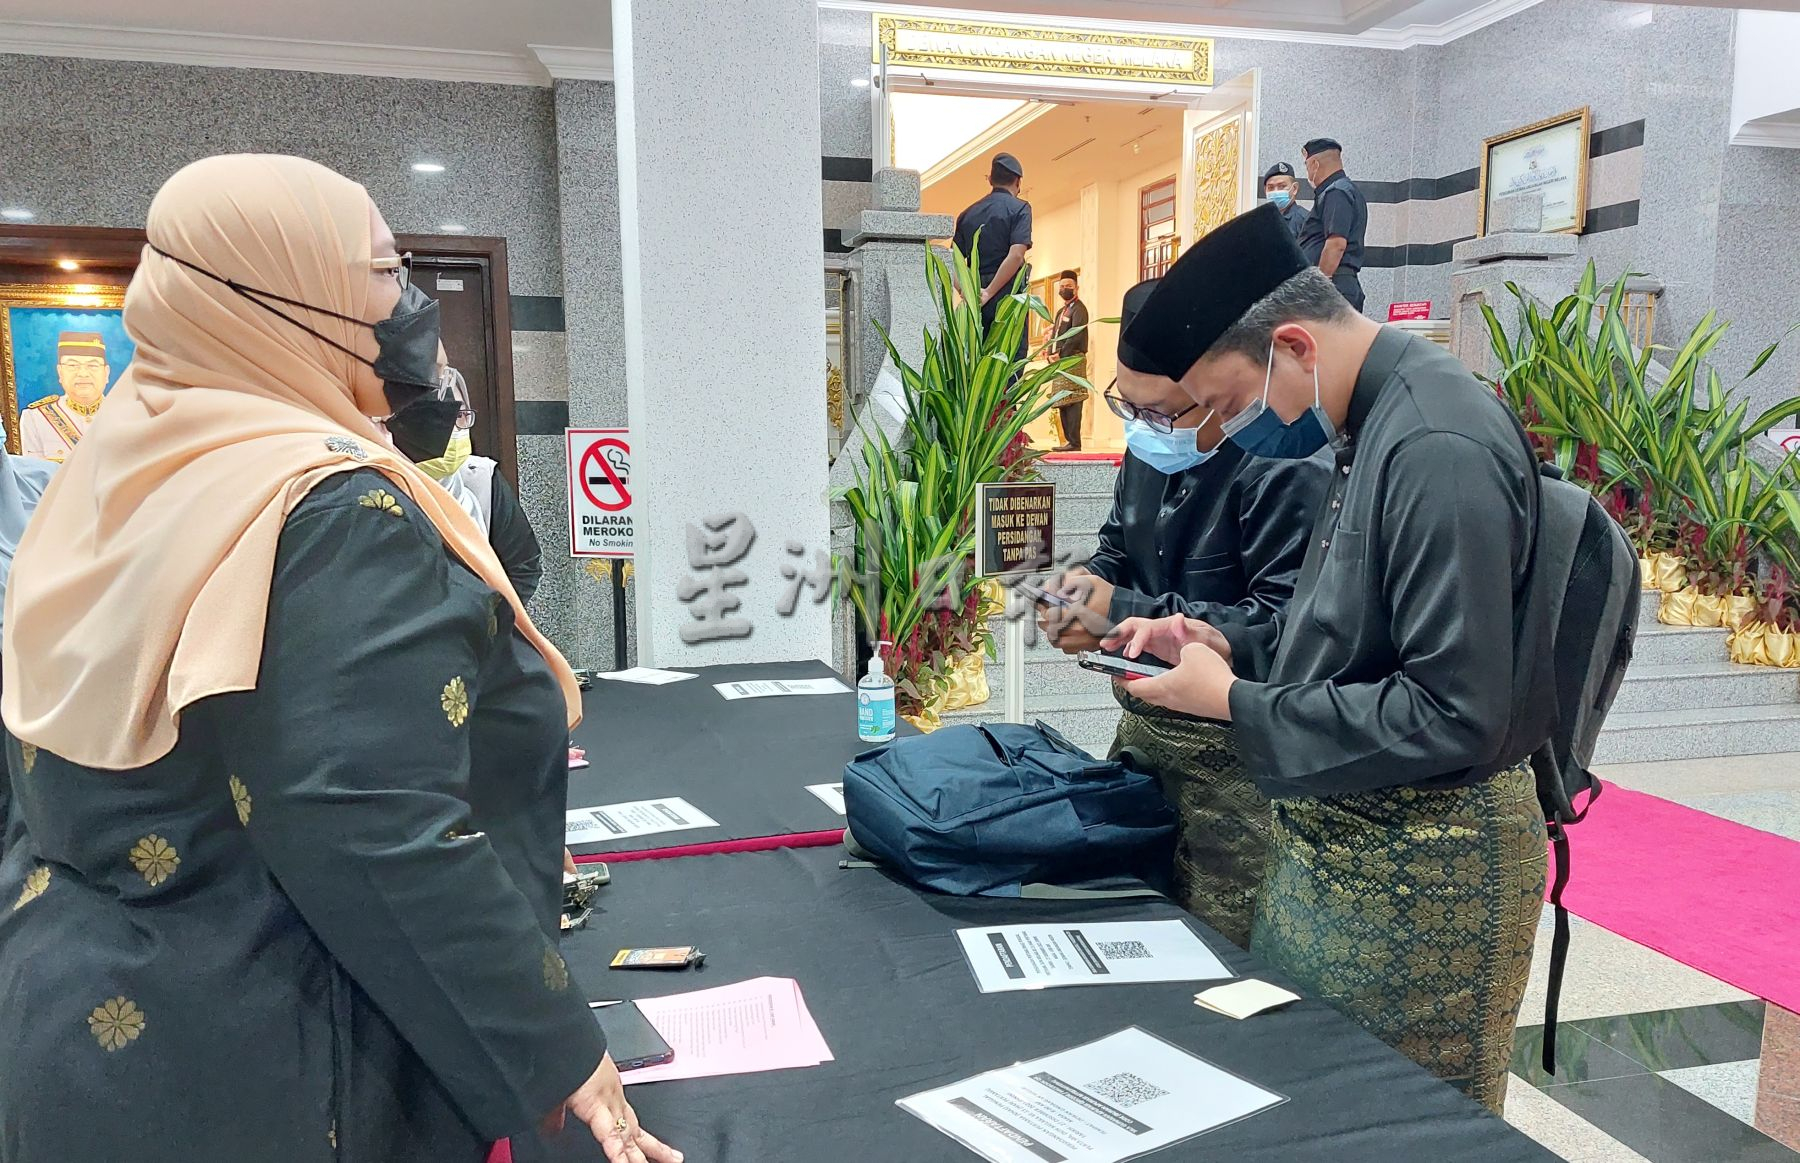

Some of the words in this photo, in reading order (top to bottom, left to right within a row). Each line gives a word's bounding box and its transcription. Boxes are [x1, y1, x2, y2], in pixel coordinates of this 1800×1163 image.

[989, 498, 1008, 511] TIDAK
[1010, 496, 1050, 510] DIBENARKAN
[991, 514, 1014, 528] MASUK
[1016, 513, 1024, 527] KE
[1026, 512, 1048, 526] DEWAN
[589, 539, 600, 547] No
[998, 529, 1042, 545] PERSIDANGAN
[1003, 548, 1023, 561] TANPA
[1025, 546, 1036, 560] PAS
